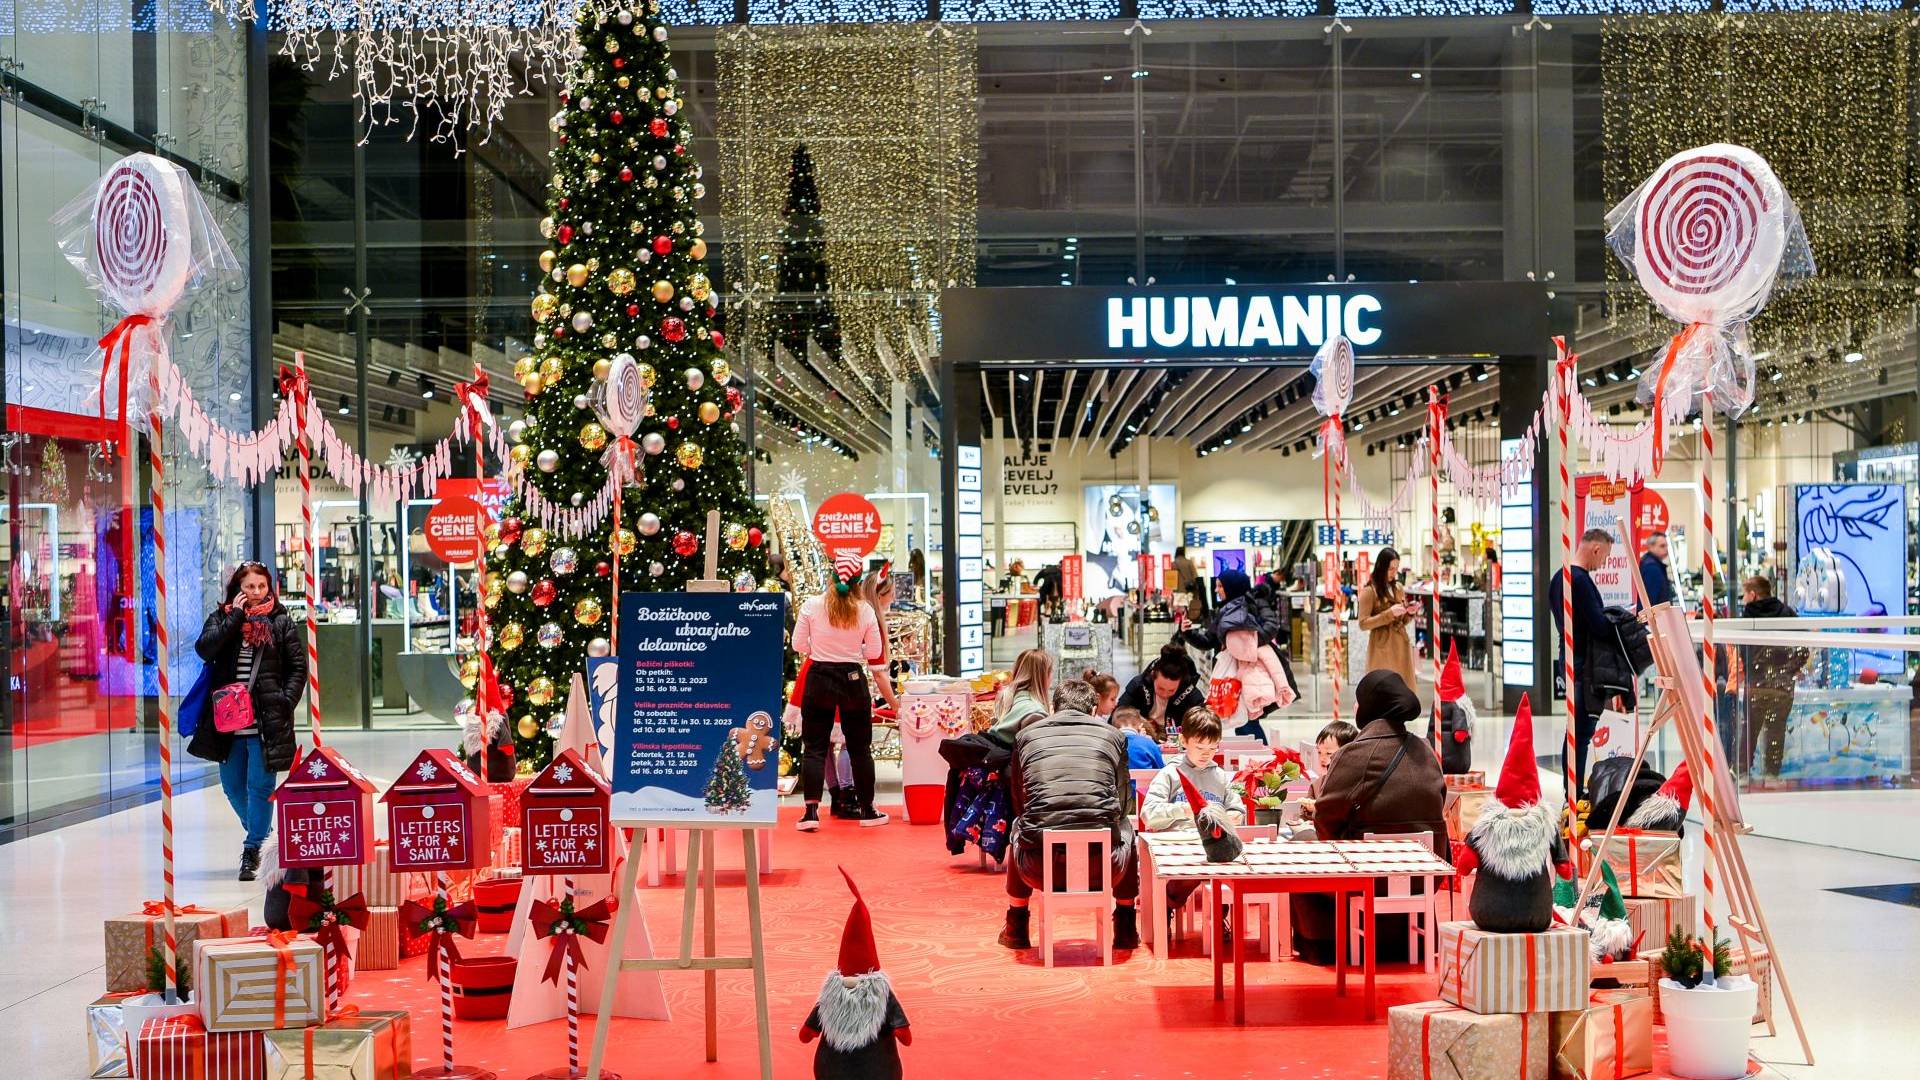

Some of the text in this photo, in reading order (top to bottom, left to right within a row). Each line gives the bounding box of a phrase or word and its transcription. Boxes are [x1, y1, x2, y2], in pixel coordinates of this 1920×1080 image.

[1107, 294, 1383, 348] HUMANIC
[1029, 455, 1048, 467] JE
[430, 514, 475, 525] ZNIŽANE
[818, 512, 864, 522] ZNIŽANE
[430, 523, 476, 537] CENE
[818, 521, 865, 534] CENE
[1608, 556, 1628, 569] POKUS
[1594, 572, 1619, 585] CIRKUS
[637, 607, 712, 621] Božičkove
[638, 637, 708, 652] delavnice
[648, 669, 673, 677] petkih:
[713, 718, 733, 726] 2023
[290, 815, 352, 832] LETTERS
[400, 820, 461, 835] LETTERS
[307, 830, 331, 843] FOR
[535, 823, 598, 838] LETTERS
[417, 835, 441, 847] FOR
[552, 838, 577, 850] FOR
[299, 842, 341, 857] SANTA
[409, 847, 451, 861] SANTA
[543, 850, 587, 864] SANTA
